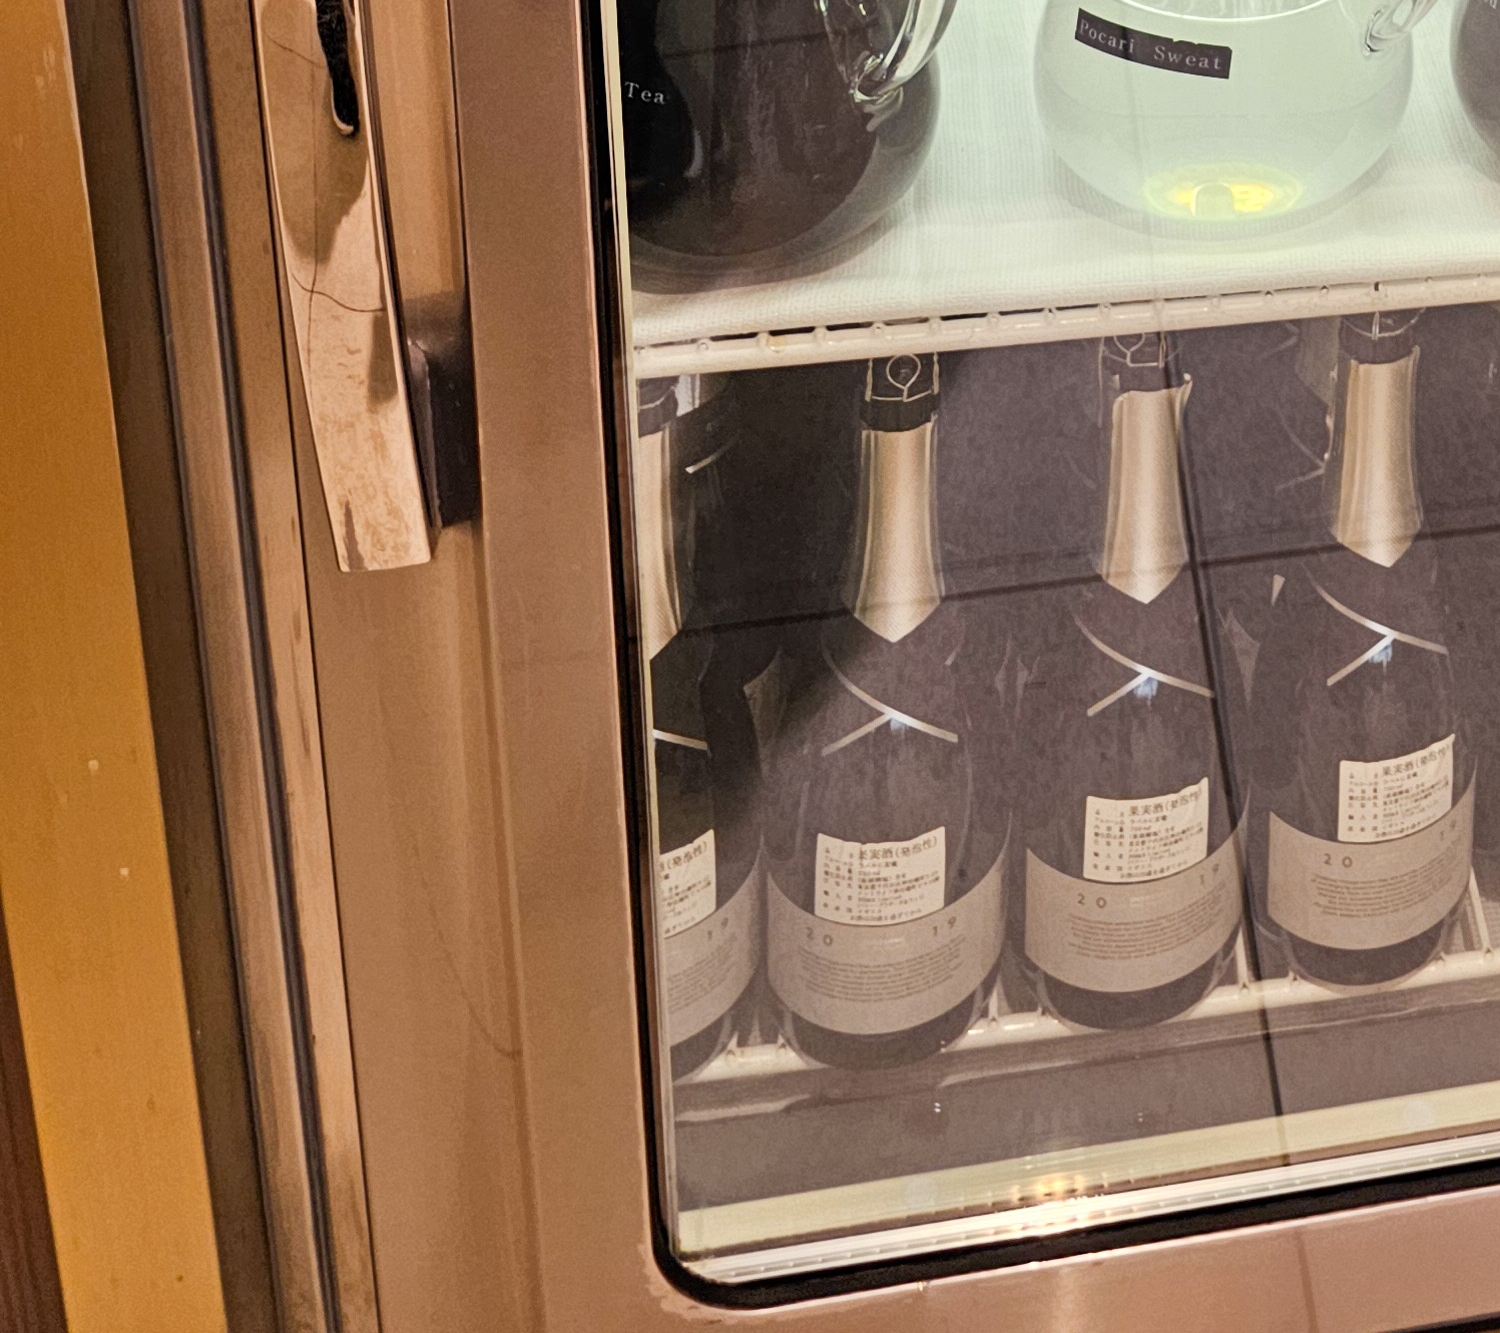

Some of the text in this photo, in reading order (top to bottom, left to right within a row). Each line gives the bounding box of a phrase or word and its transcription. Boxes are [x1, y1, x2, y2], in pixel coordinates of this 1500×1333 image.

[1078, 18, 1222, 70] Pocari Sweat
[624, 81, 666, 105] Tea
